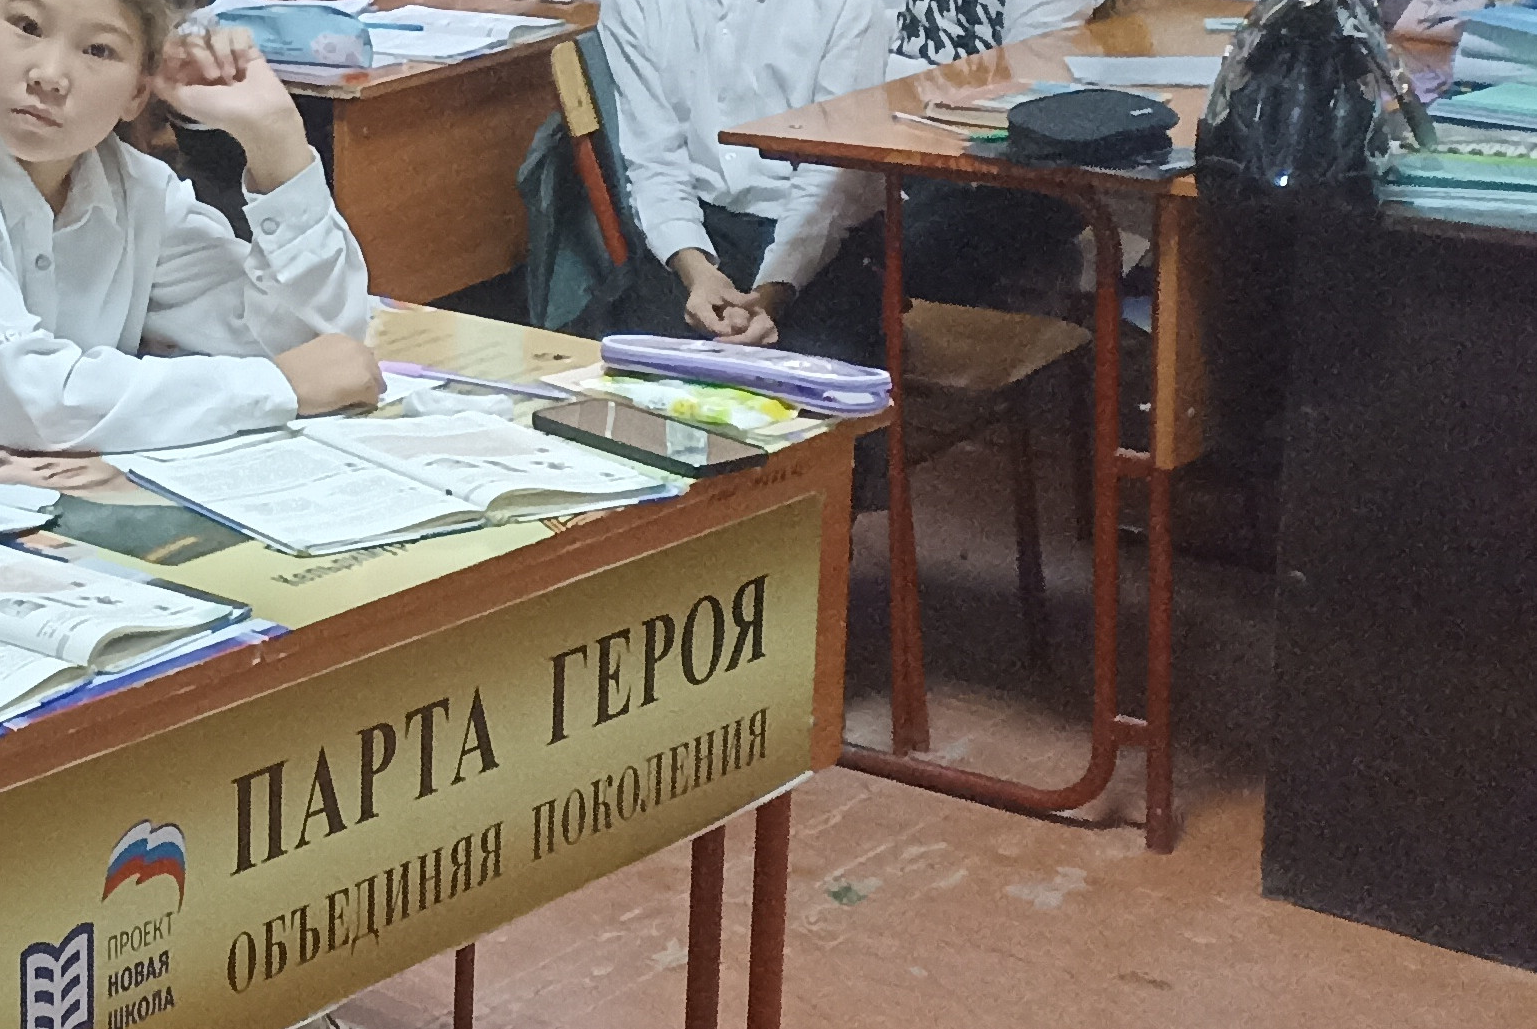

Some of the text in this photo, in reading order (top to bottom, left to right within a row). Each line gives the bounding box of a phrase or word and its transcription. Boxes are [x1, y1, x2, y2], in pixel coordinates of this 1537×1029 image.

[230, 573, 769, 877] ПАРТА ГЕРОЯ
[226, 706, 769, 995] ОБЪЕДИНЯЯ ПОКОЛЕНИЯ
[107, 912, 175, 961] ПРОЕКТ
[107, 950, 170, 998] НОВАЯ
[107, 986, 175, 1029] ШКОЛА
